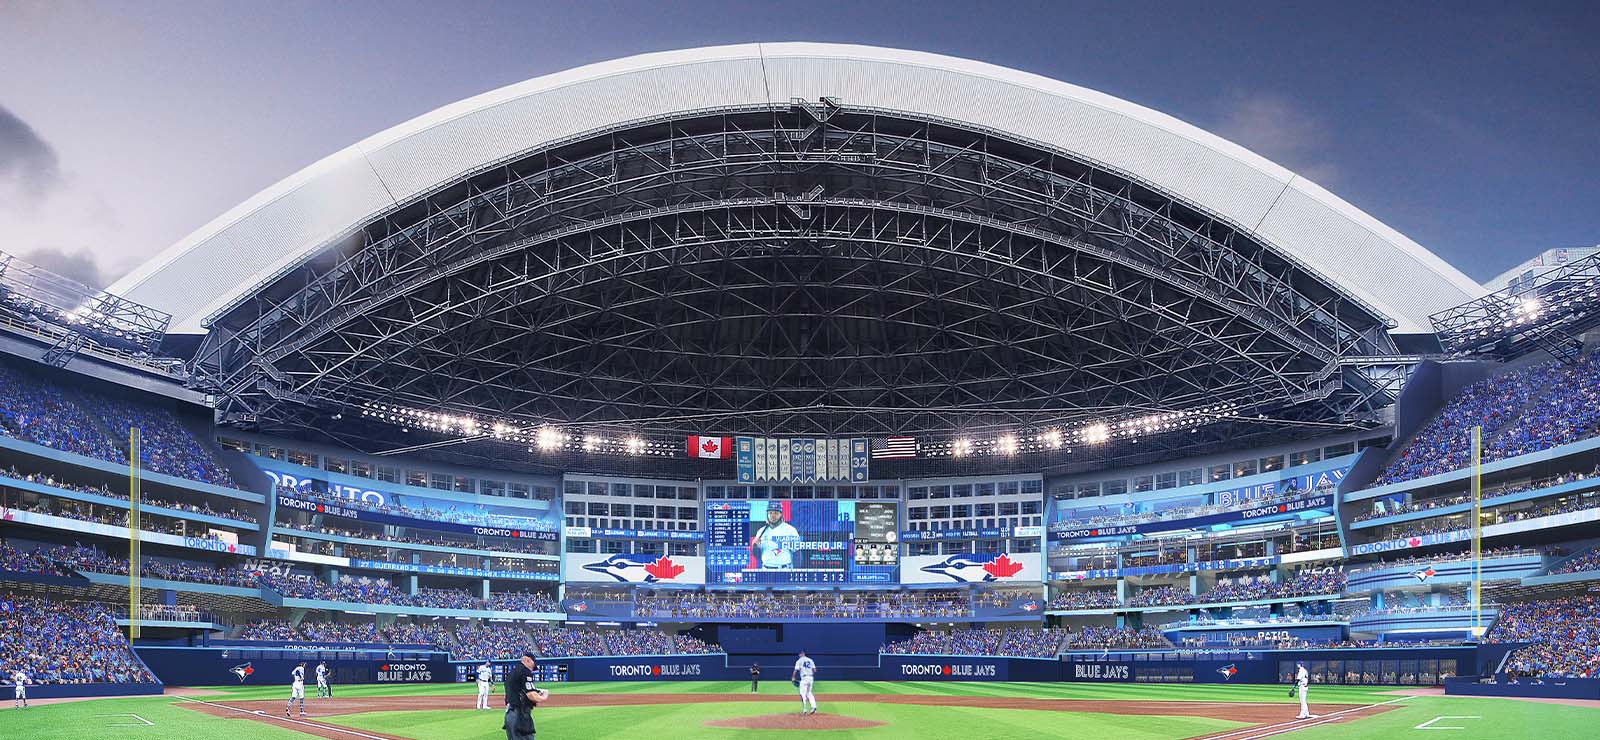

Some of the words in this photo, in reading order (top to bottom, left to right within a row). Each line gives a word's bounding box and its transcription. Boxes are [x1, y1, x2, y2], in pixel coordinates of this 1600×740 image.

[853, 457, 867, 468] 32
[279, 496, 316, 511] TORONTO
[324, 505, 341, 517] BLUE
[341, 507, 358, 519] JAYS
[1242, 505, 1278, 519] TORONTO
[1287, 500, 1305, 511] BLUE
[1306, 497, 1326, 508] JAYS
[473, 527, 510, 537] TORONTO
[519, 530, 537, 539] BLUE
[538, 531, 556, 540] JAYS
[1057, 529, 1090, 539] TORONTO
[1098, 527, 1116, 536] BLUE
[1117, 525, 1137, 534] JAYS
[184, 536, 227, 552] TORONTO
[781, 541, 830, 549] GUERRERO
[831, 541, 845, 549] JR.
[1354, 539, 1407, 554] TORONTO
[823, 573, 828, 581] 2
[838, 573, 844, 581] 2
[389, 663, 426, 671] TORONTO
[610, 665, 652, 676] TORONTO
[661, 665, 680, 676] BLUE
[681, 664, 701, 675] JAYS
[802, 660, 811, 669] 42
[901, 664, 942, 675] TORONTO
[951, 664, 972, 675] BLUE
[974, 665, 996, 676] JAYS
[377, 671, 403, 681] BLUE
[405, 671, 432, 681] JAYS
[1075, 664, 1101, 679] BLUE
[1102, 665, 1129, 679] JAYS
